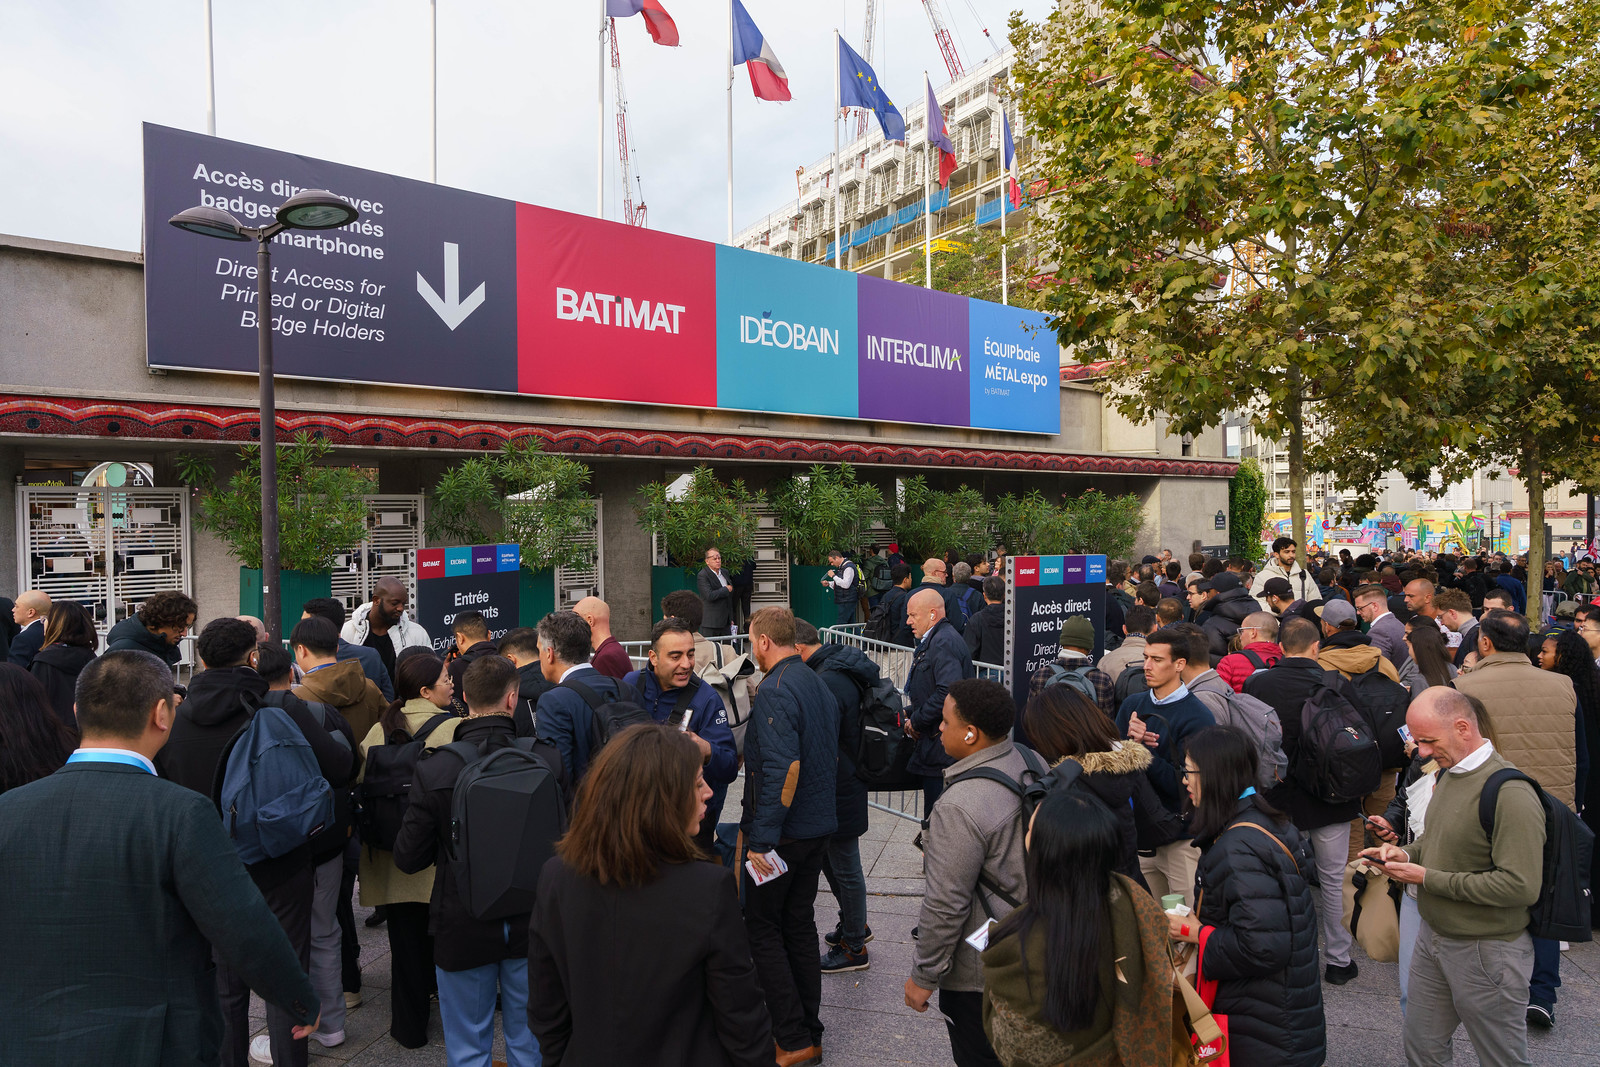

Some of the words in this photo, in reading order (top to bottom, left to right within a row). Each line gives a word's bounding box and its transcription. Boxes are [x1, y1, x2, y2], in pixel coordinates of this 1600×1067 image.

[192, 163, 264, 192] Accès
[215, 257, 279, 283] Diret
[283, 268, 354, 293] Access
[360, 278, 386, 297] for
[220, 283, 296, 309] Prined
[301, 297, 322, 312] or
[327, 297, 386, 320] Digital
[240, 310, 307, 336] Bdge
[313, 318, 385, 342] Holders
[866, 335, 963, 372] INTERCLIMA
[984, 336, 1041, 364] ÉQUIPbaie
[984, 387, 990, 396] by
[985, 364, 1048, 393] MÉTALexpo
[454, 590, 490, 607] Entrée
[1031, 600, 1062, 616] Accès
[1064, 598, 1092, 613] direct
[1030, 620, 1054, 633] avec
[1033, 643, 1057, 656] Direct
[1025, 660, 1037, 672] for
